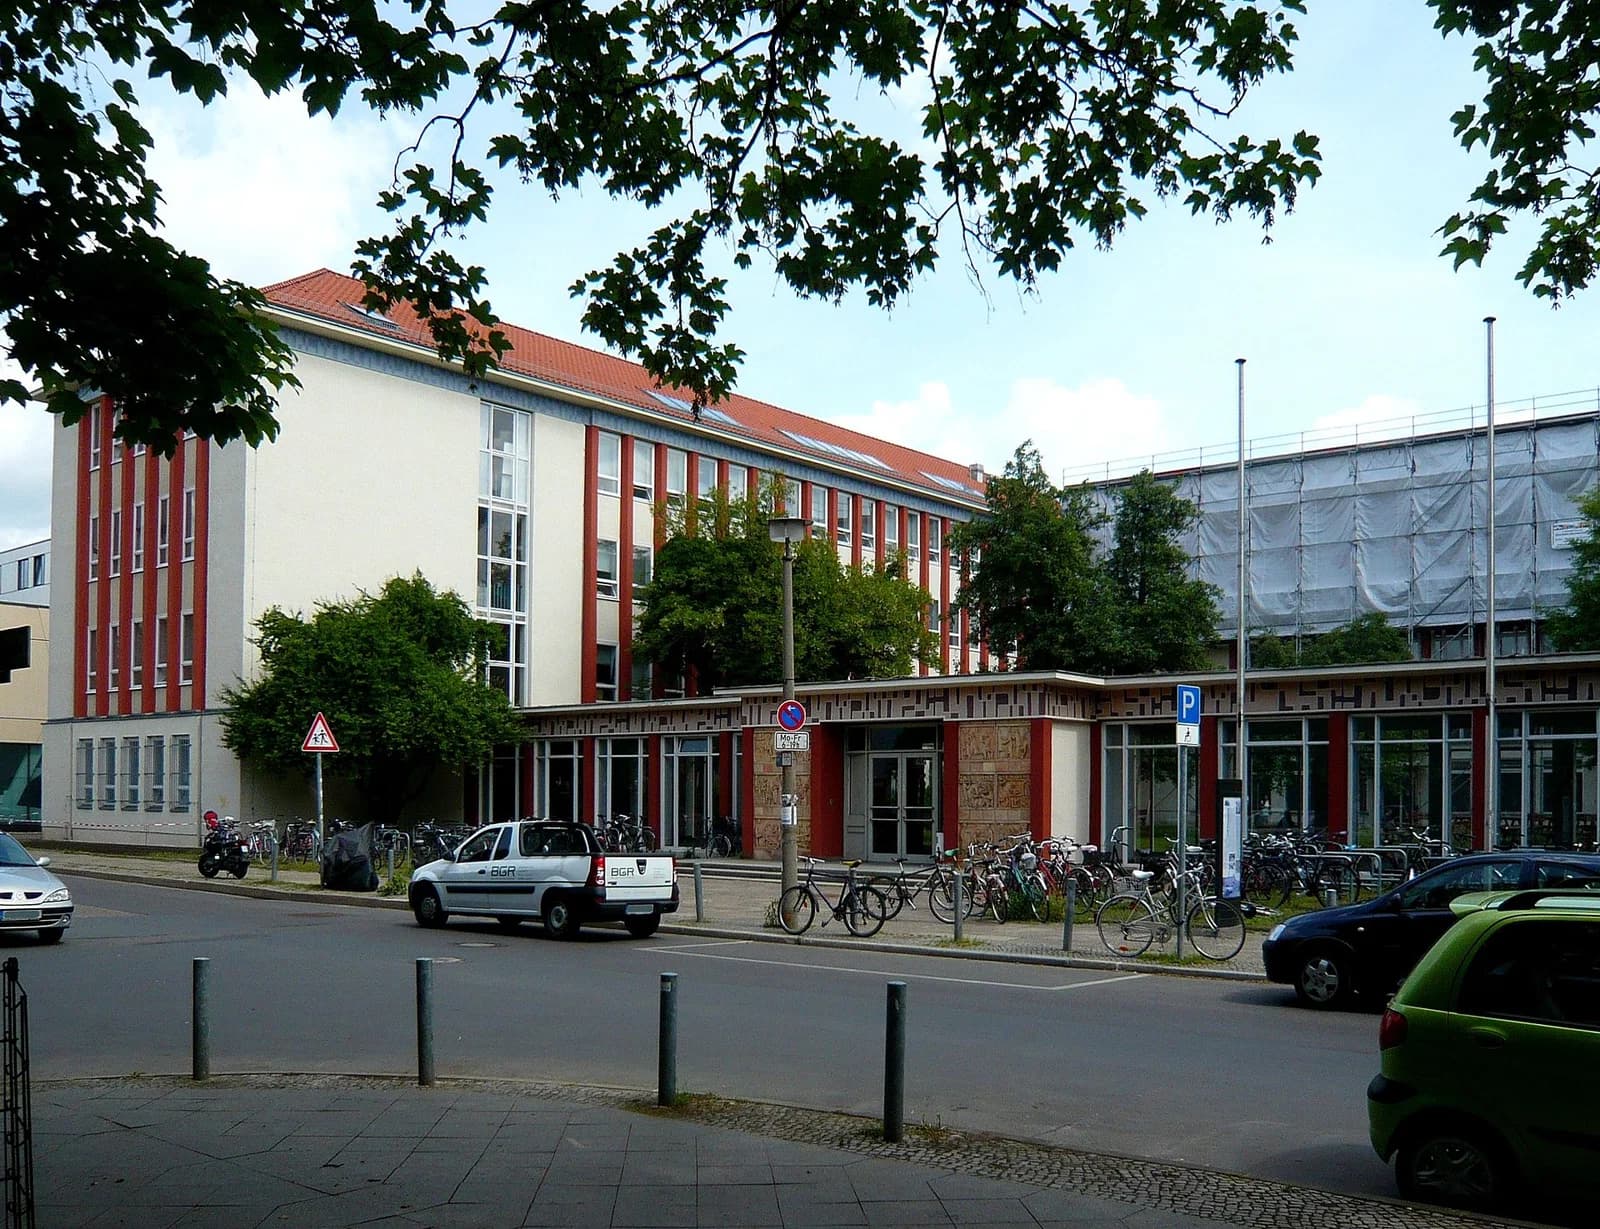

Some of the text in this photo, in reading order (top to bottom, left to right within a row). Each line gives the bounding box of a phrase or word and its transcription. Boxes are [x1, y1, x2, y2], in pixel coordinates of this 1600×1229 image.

[1183, 691, 1195, 719] P
[491, 865, 516, 877] BGR
[611, 867, 635, 877] BGR
